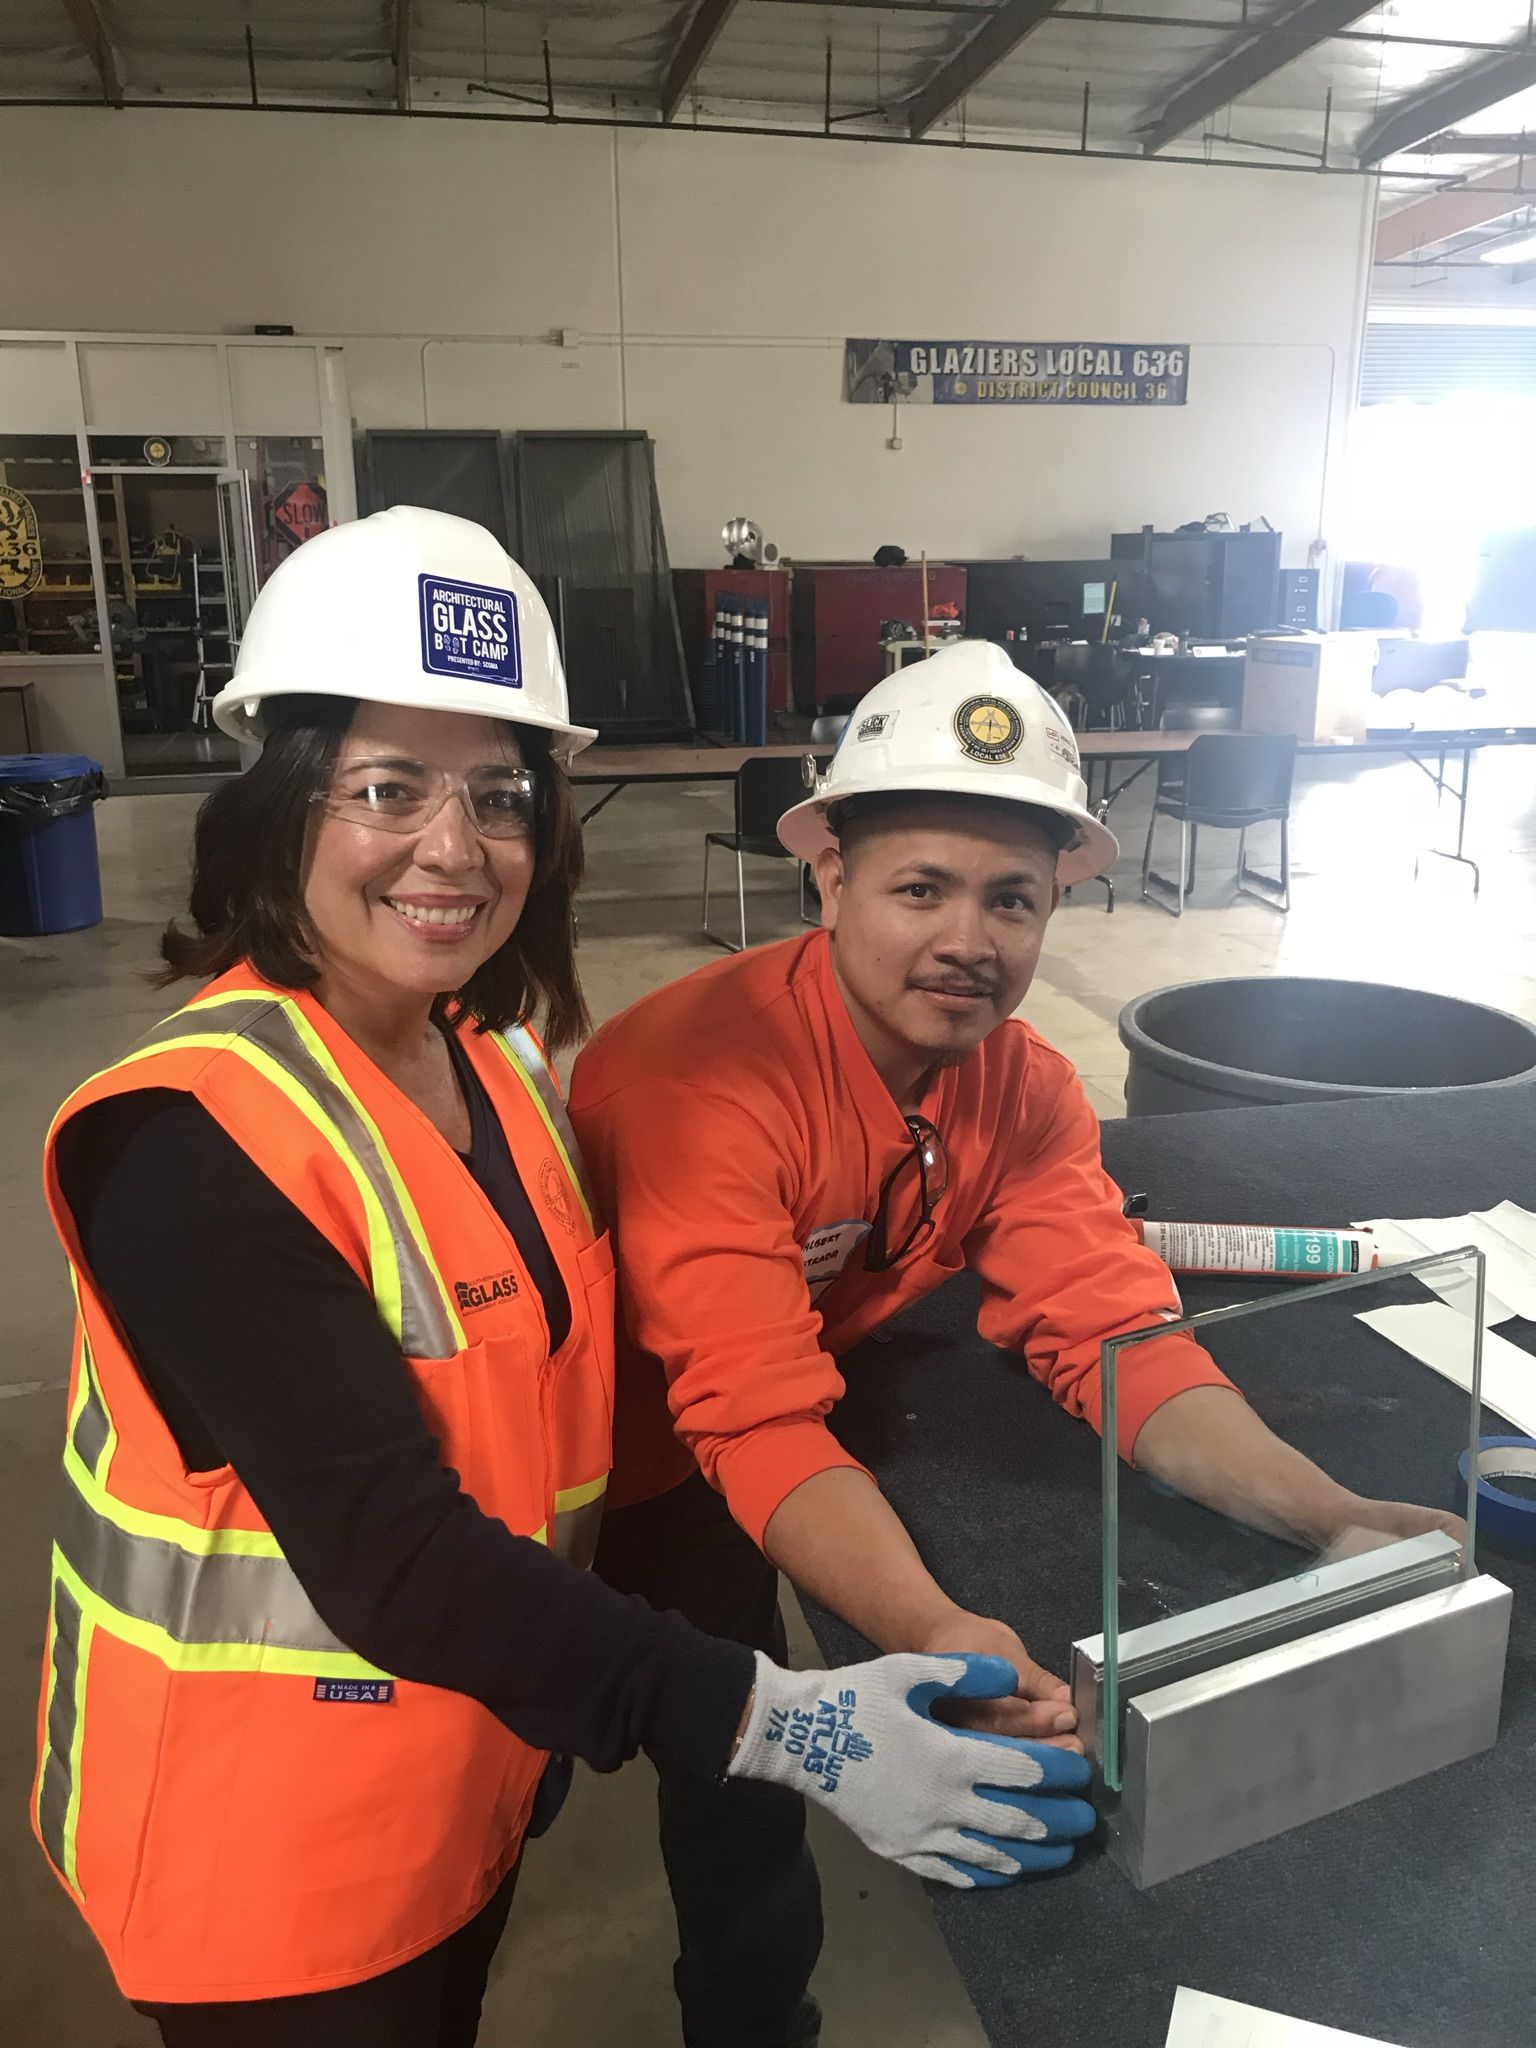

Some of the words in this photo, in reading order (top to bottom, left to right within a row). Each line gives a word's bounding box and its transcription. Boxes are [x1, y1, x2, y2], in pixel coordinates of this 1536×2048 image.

[910, 347, 1038, 376] GLAZIERS
[1045, 348, 1124, 376] LOCAL
[1132, 350, 1184, 377] 636
[977, 381, 1060, 399] DISTRICT
[1065, 381, 1138, 399] COUNCIL
[1145, 382, 1168, 399] 36
[283, 502, 327, 525] SLOW
[433, 589, 506, 613] ARCHITECTURAL
[432, 602, 508, 643] GLASS
[447, 654, 474, 667] PRESENTED
[472, 639, 509, 661] CAMP
[970, 749, 994, 760] LOCAL
[1326, 1245, 1335, 1274] CORNIN
[468, 1274, 519, 1308] GLASS
[329, 1690, 375, 1701] USA
[784, 1707, 815, 1756] 300
[802, 1698, 838, 1775] ATLAS
